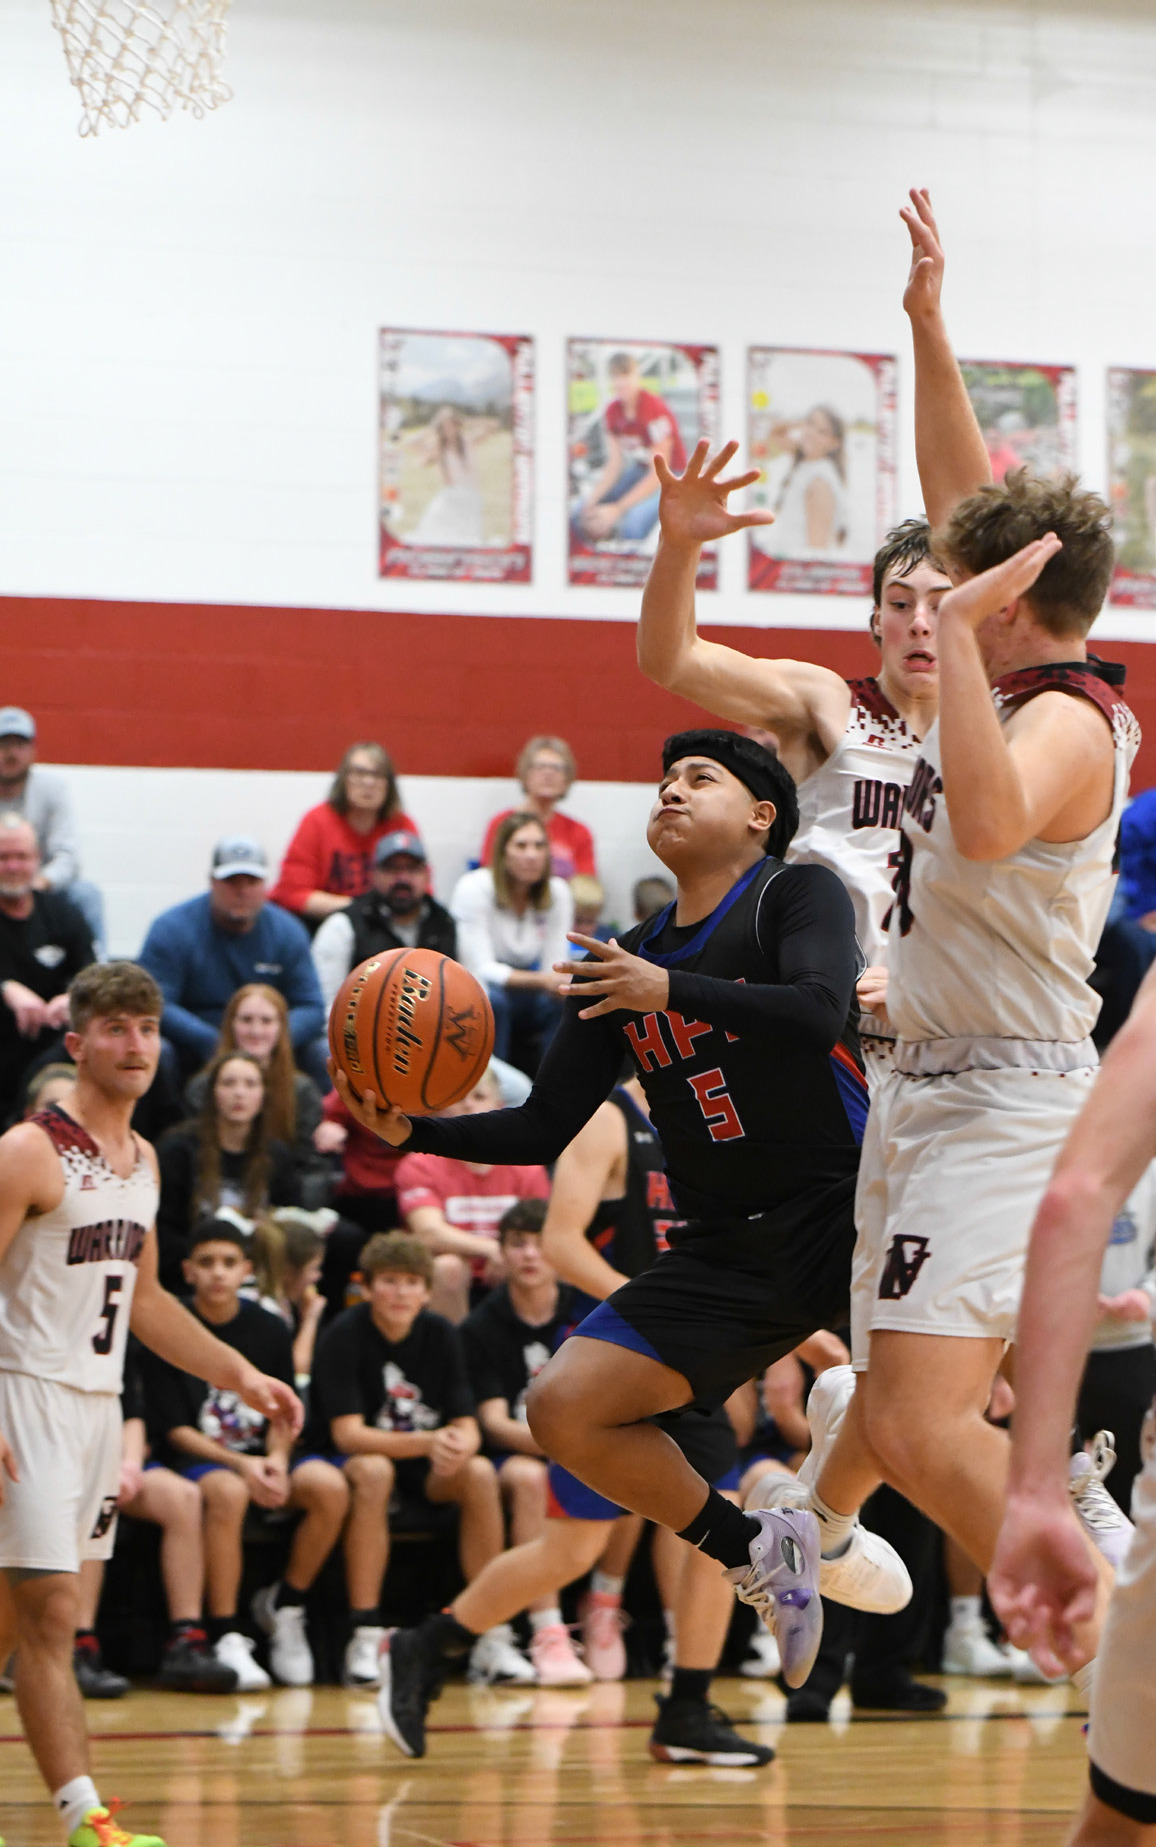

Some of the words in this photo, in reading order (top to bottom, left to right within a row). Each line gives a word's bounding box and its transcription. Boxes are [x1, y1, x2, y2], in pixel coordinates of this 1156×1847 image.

[393, 967, 433, 1077] Baden
[686, 1067, 746, 1143] 5
[91, 1274, 124, 1356] 5
